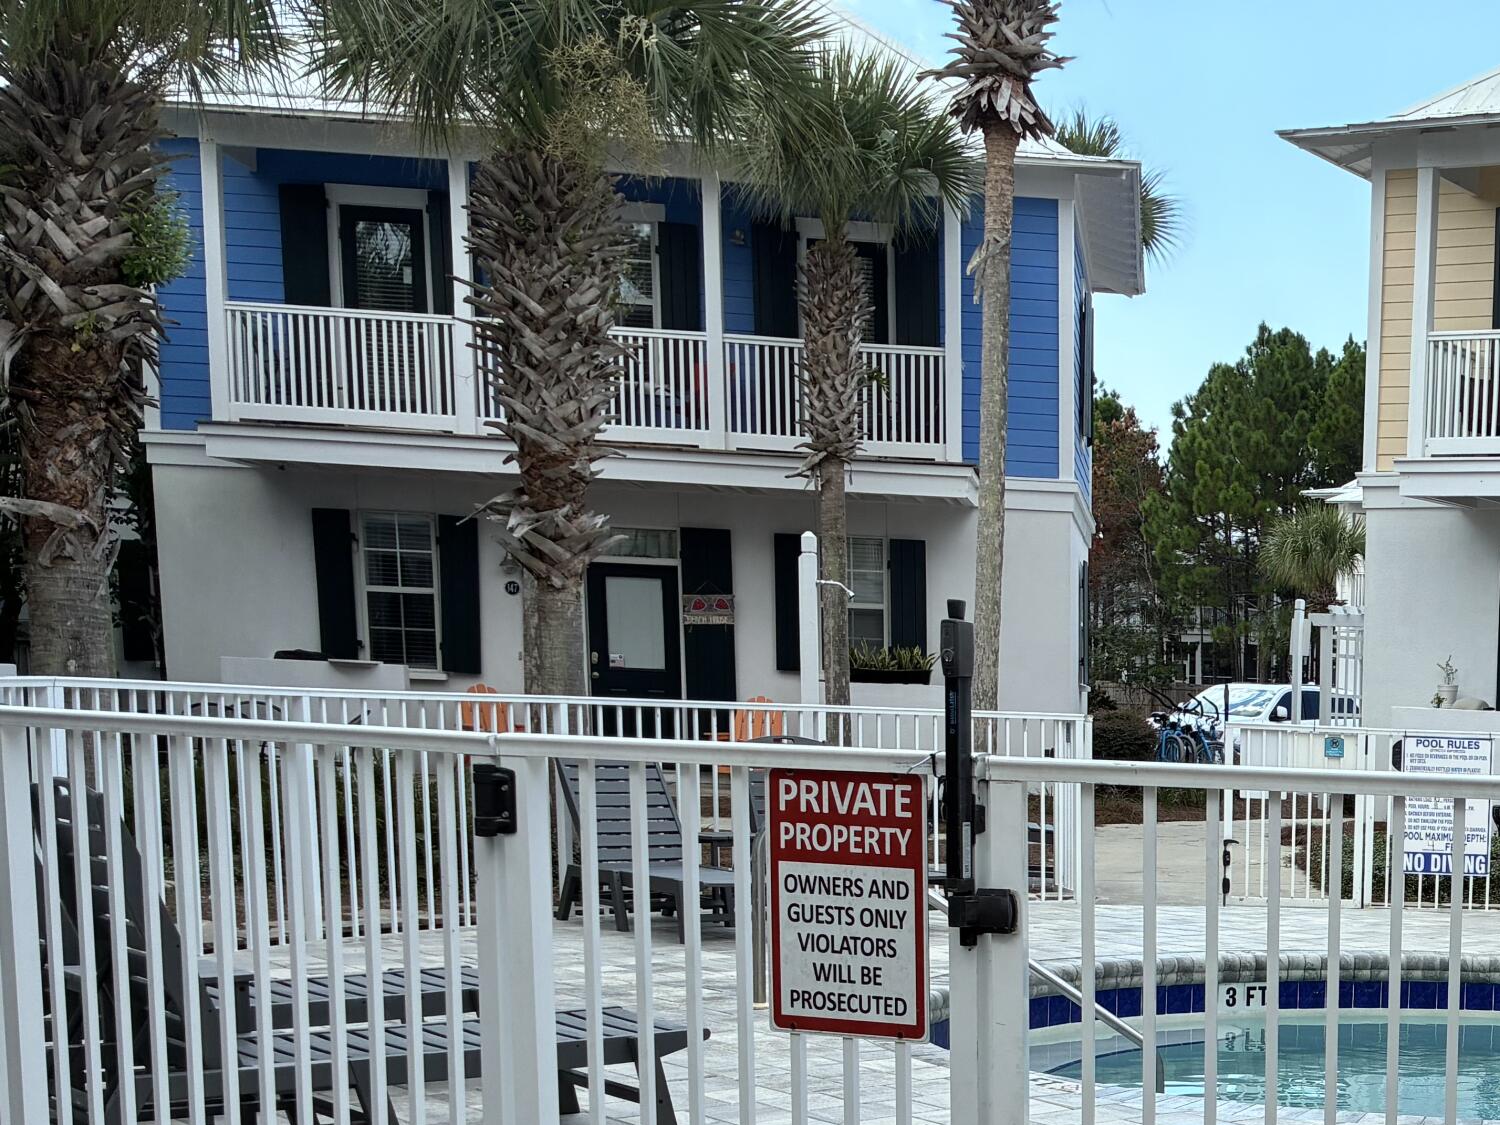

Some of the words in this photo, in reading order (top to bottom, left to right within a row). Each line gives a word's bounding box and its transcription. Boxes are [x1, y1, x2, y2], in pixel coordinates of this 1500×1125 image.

[1415, 739, 1444, 749] POOL
[1447, 740, 1481, 750] RULES
[777, 778, 913, 818] PRIVATE
[779, 821, 912, 856] PROPERTY
[1404, 832, 1424, 840] POOL
[1425, 832, 1453, 842] MAXIMU
[1464, 834, 1486, 842] EPTH:
[1403, 852, 1425, 872] NO
[783, 873, 864, 898] OWNERS
[868, 879, 910, 900] AND
[787, 903, 855, 926] GUESTS
[859, 907, 907, 930] ONLY
[797, 932, 897, 958] VIOLATORS
[812, 962, 856, 984] WILL
[861, 966, 883, 986] BE
[790, 989, 908, 1017] PROSECUTED
[1225, 986, 1237, 1008] 3
